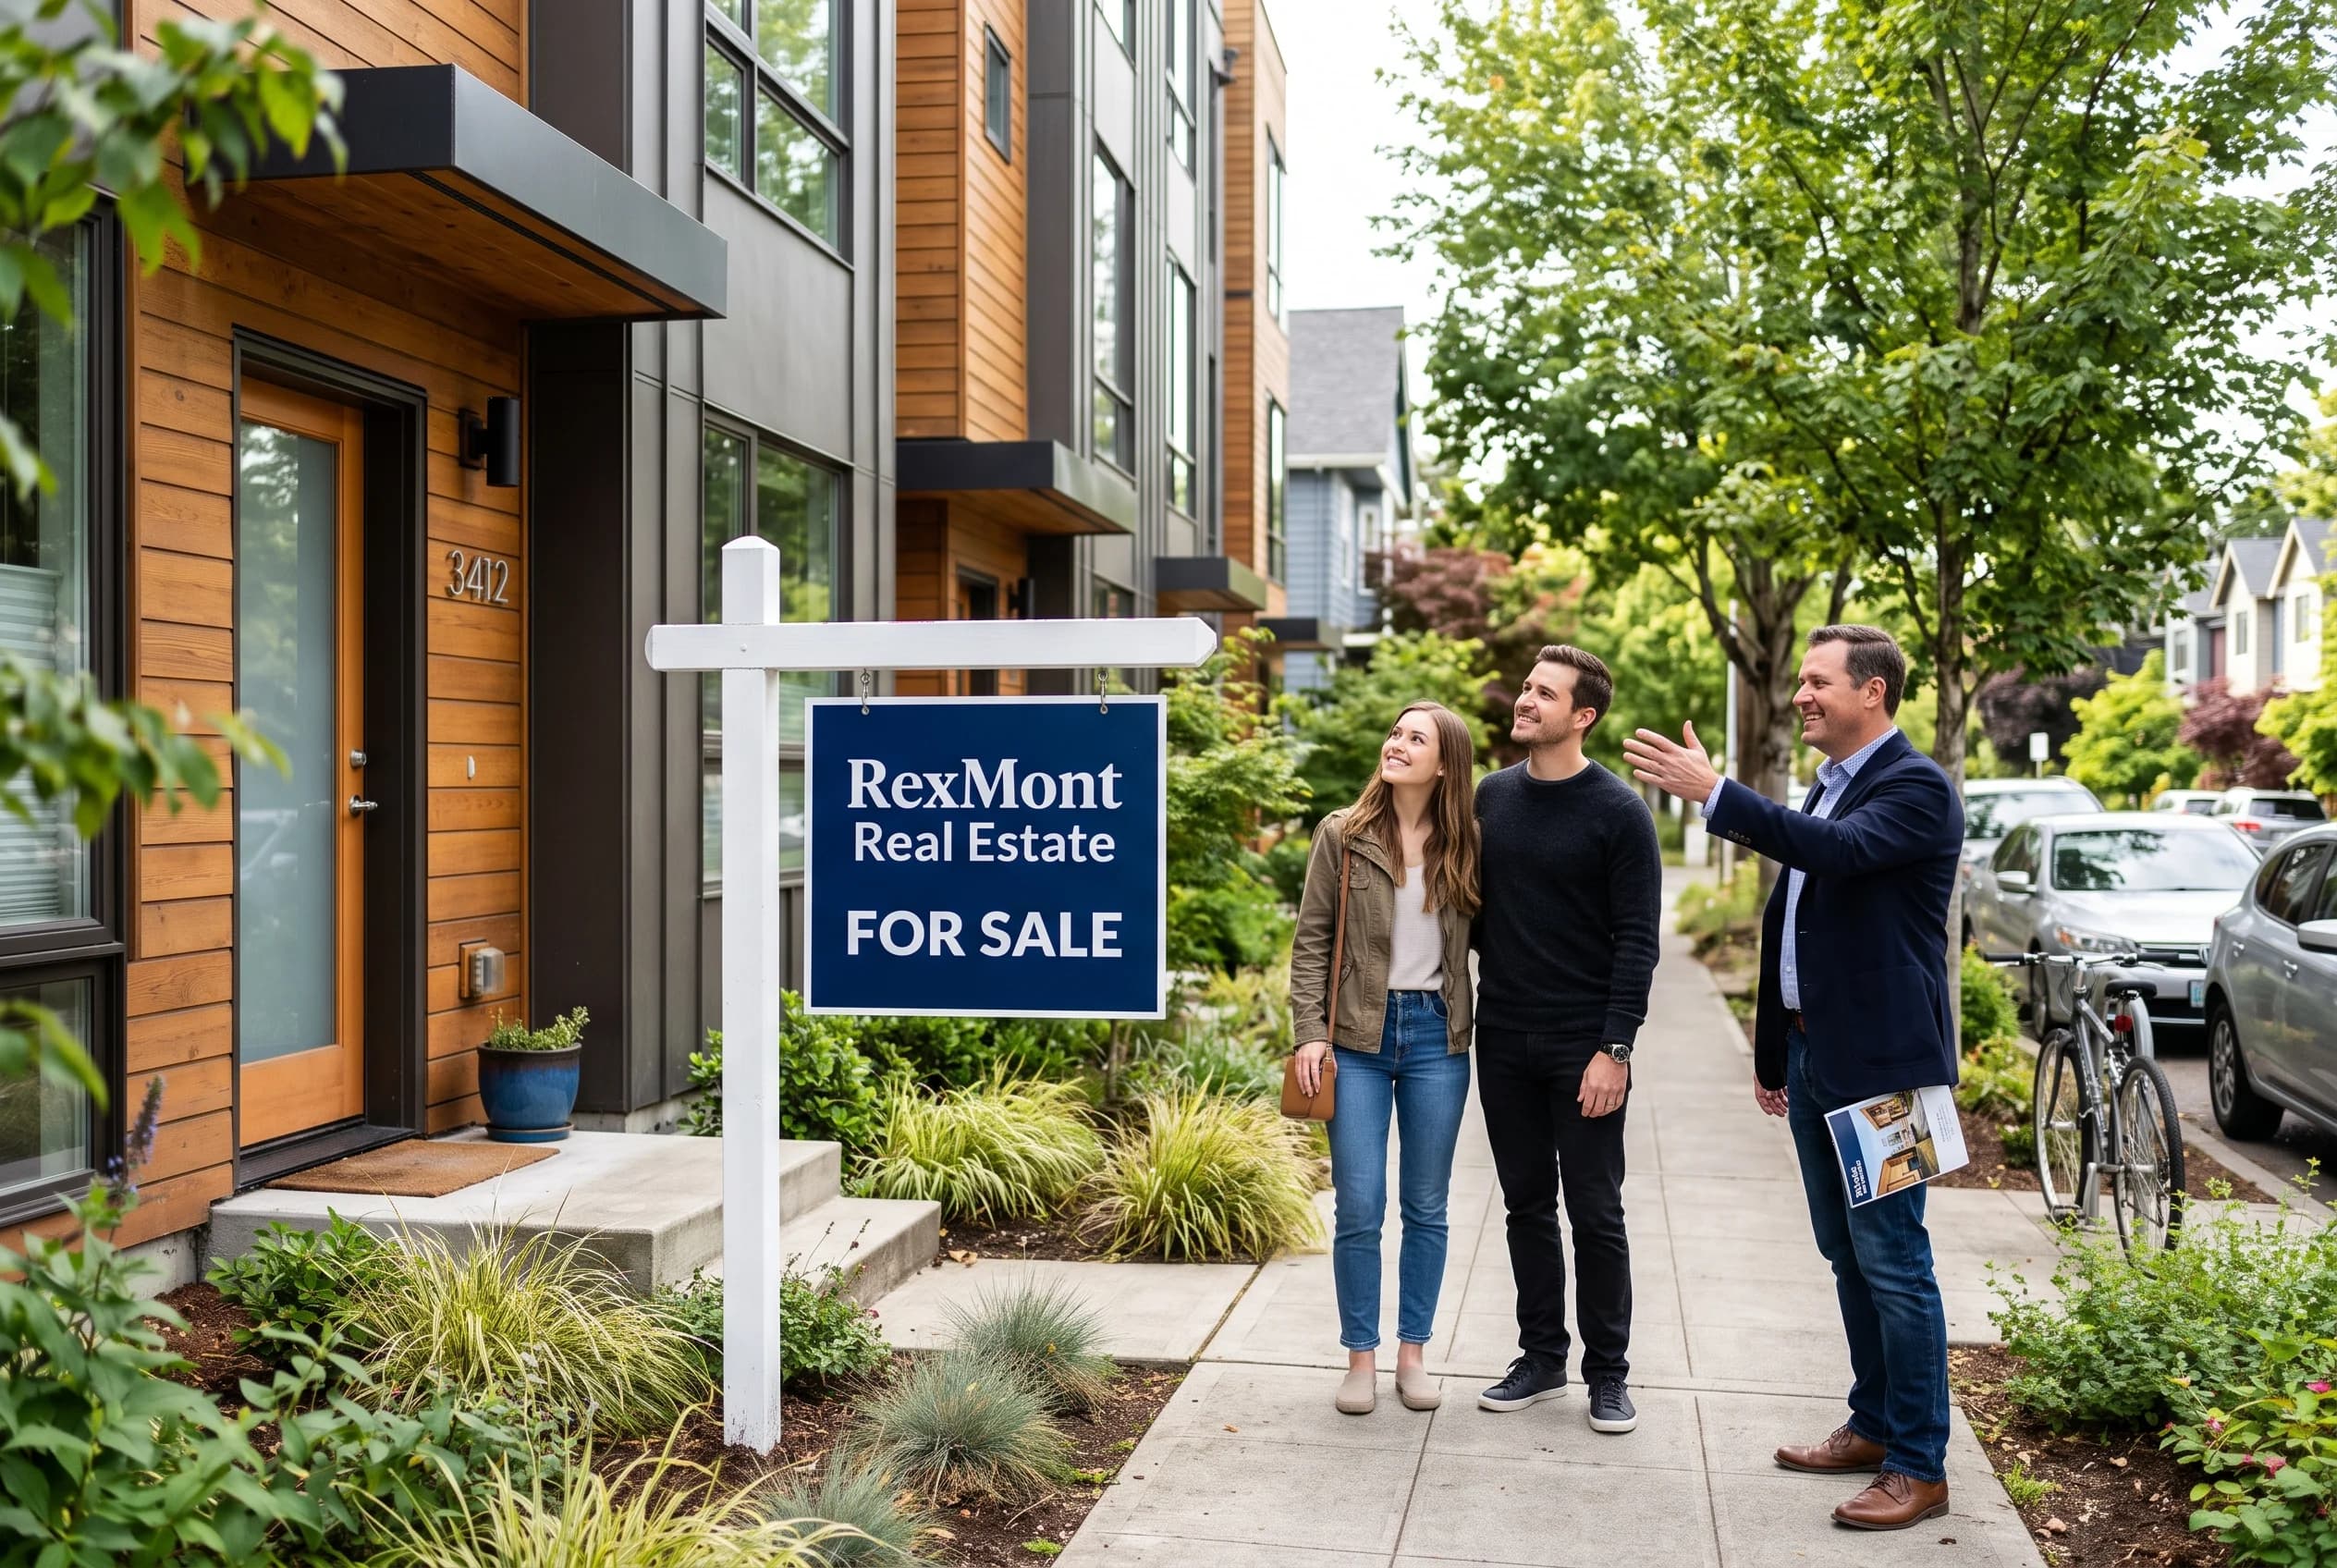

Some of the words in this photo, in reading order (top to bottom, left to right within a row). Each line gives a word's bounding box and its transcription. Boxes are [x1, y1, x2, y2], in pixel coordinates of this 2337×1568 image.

[448, 549, 509, 604] 3412
[847, 758, 1123, 810] RexMont
[855, 821, 952, 862] Real
[969, 822, 1115, 863] Estate
[847, 910, 966, 957] FOR
[979, 911, 1122, 958] SALE
